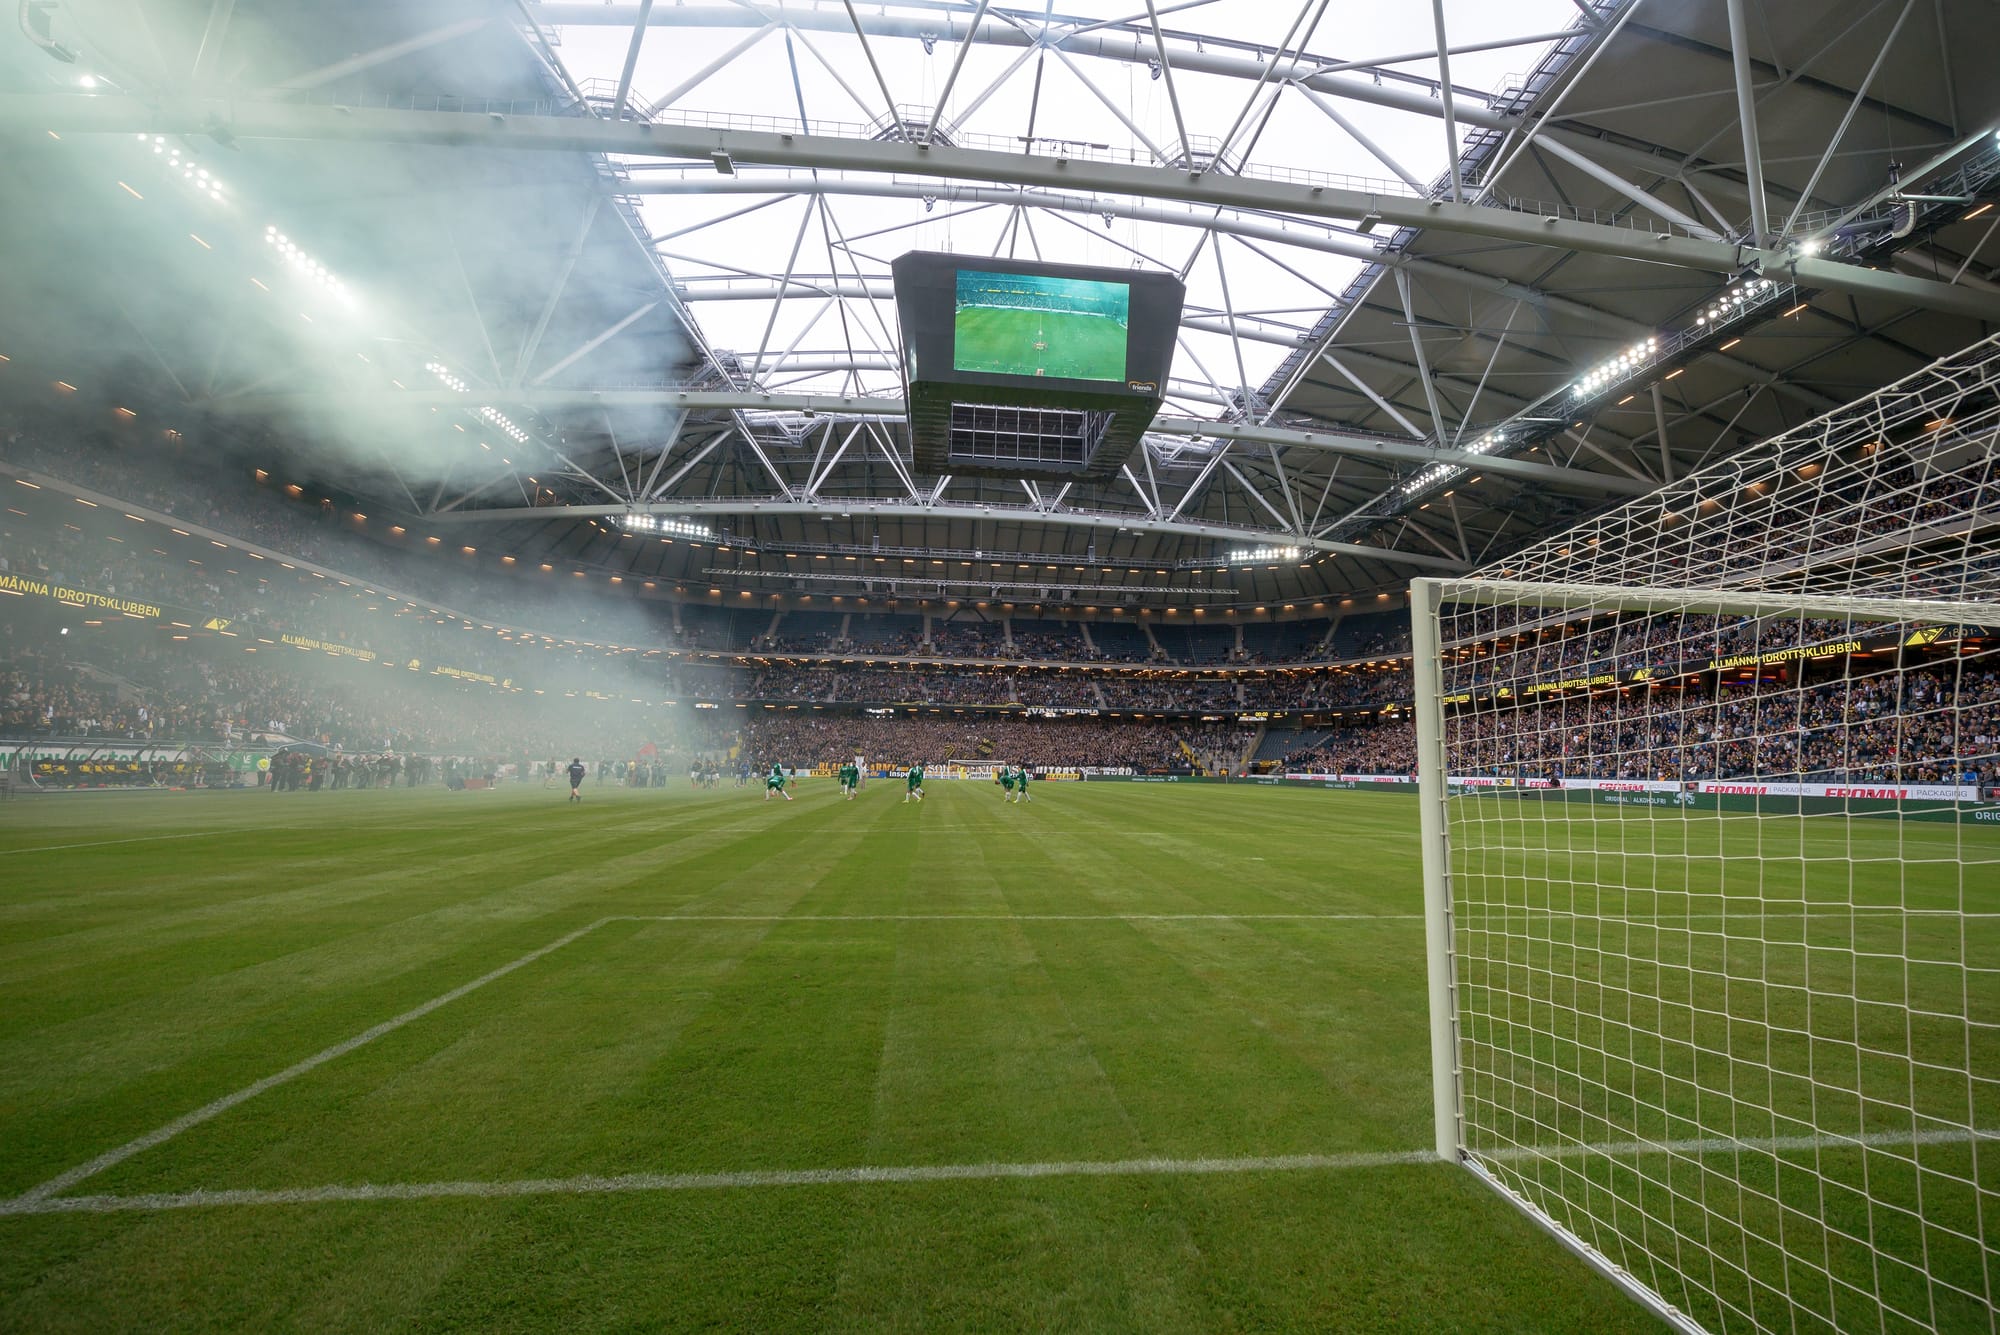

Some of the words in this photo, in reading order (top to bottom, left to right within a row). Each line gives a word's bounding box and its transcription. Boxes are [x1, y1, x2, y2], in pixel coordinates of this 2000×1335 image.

[0, 576, 48, 595] MÄNNA
[53, 587, 160, 617] IDROTTSKLUBBEN
[281, 634, 320, 649] ALLMÄNNA
[1709, 657, 1759, 669] ALLMÄNNA
[1762, 641, 1861, 663] IDROTTSKLUBBEN
[1527, 683, 1557, 693] ALLMÄNNA
[1558, 675, 1614, 689] IDROTTSKLUBBEN
[1705, 785, 1767, 795] FROMM
[1825, 788, 1907, 799] FROMM
[1917, 789, 1967, 798] PACKAGING
